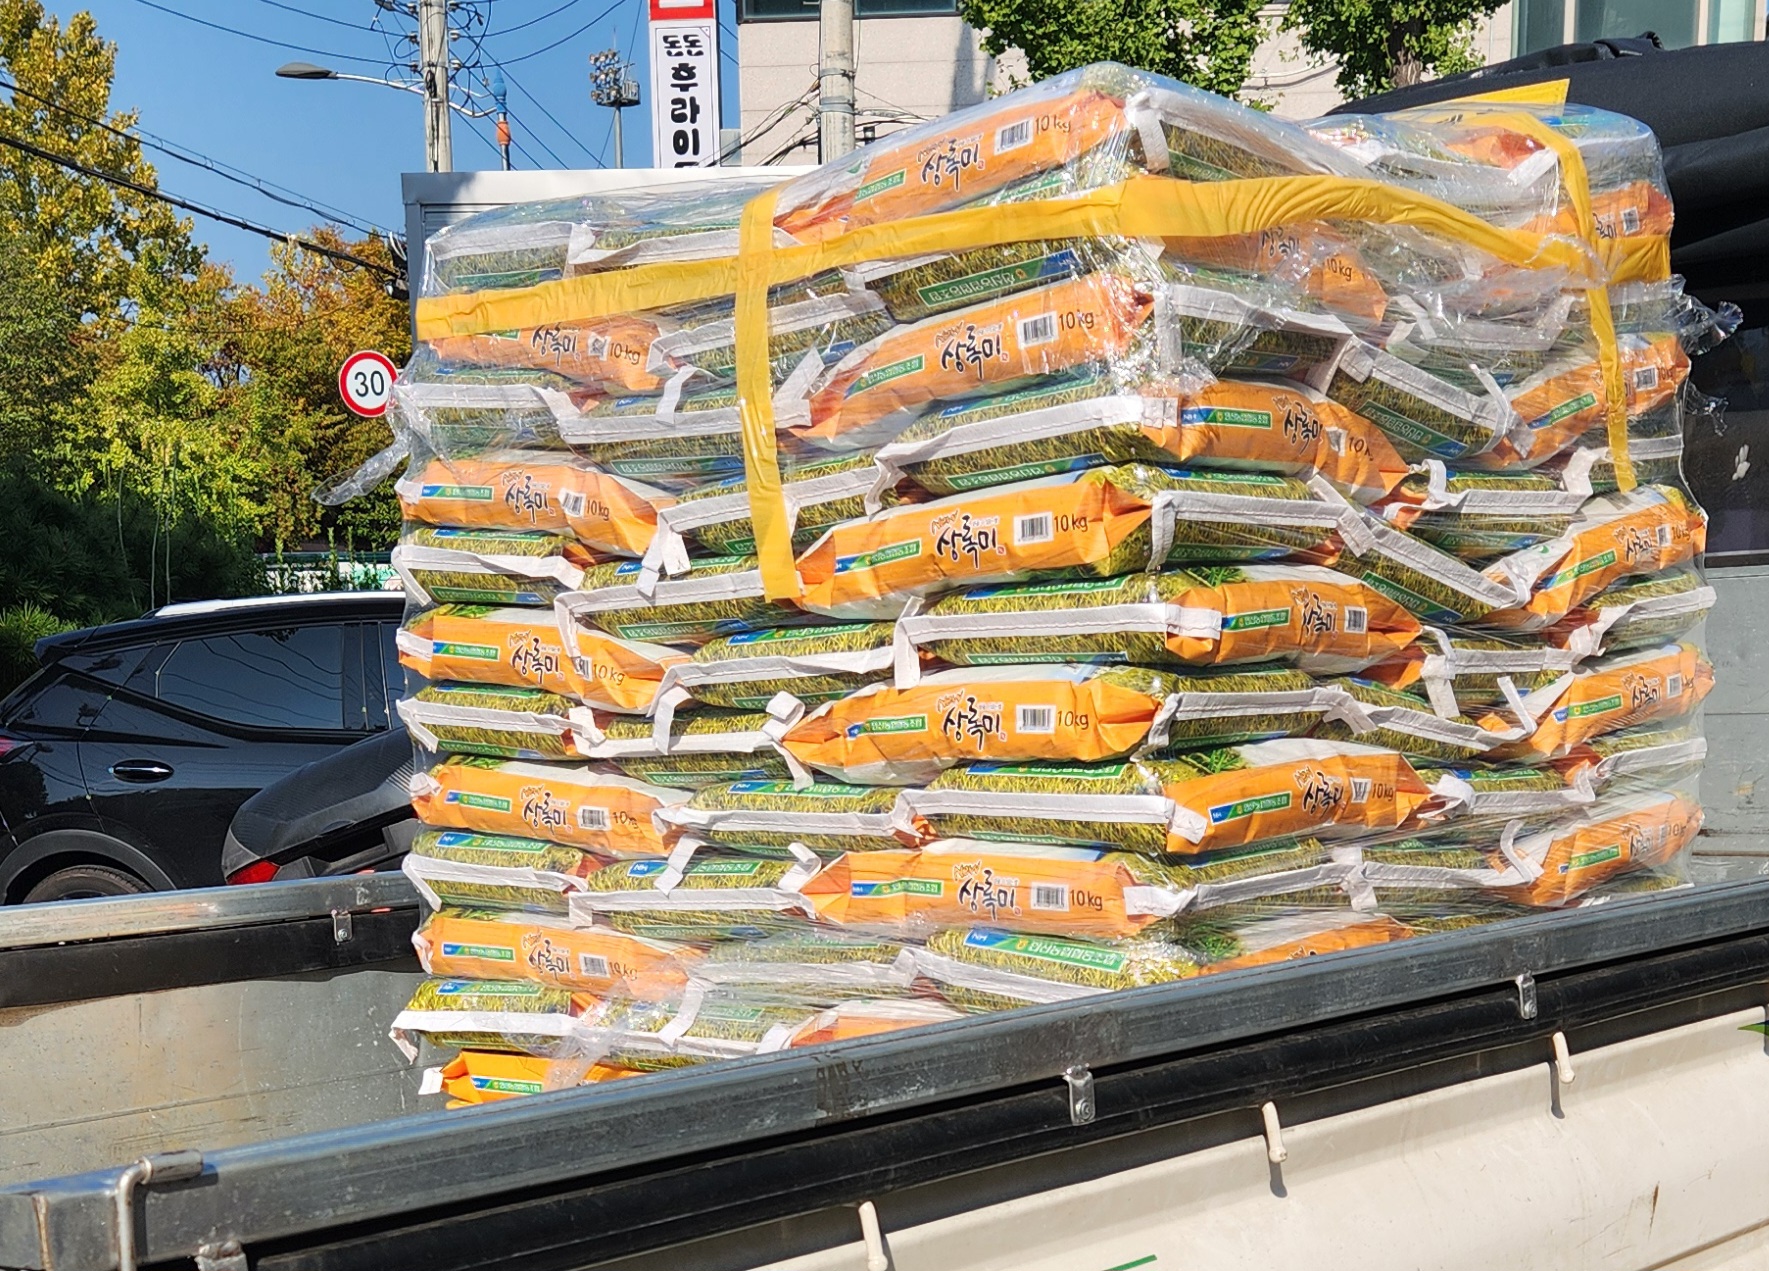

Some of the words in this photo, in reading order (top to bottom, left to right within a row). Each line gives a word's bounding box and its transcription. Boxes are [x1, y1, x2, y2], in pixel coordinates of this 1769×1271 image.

[662, 34, 704, 57] 돈돈
[670, 63, 700, 168] 후라이
[922, 138, 980, 191] 상록미
[941, 325, 1002, 379] 상록미
[354, 371, 385, 397] 30
[506, 476, 549, 524] 상록미
[936, 515, 998, 569] 상록미
[512, 638, 560, 685] 상록미
[944, 697, 1002, 750] 상록미
[959, 869, 1016, 921] 상록미
[1069, 889, 1104, 912] 10kg
